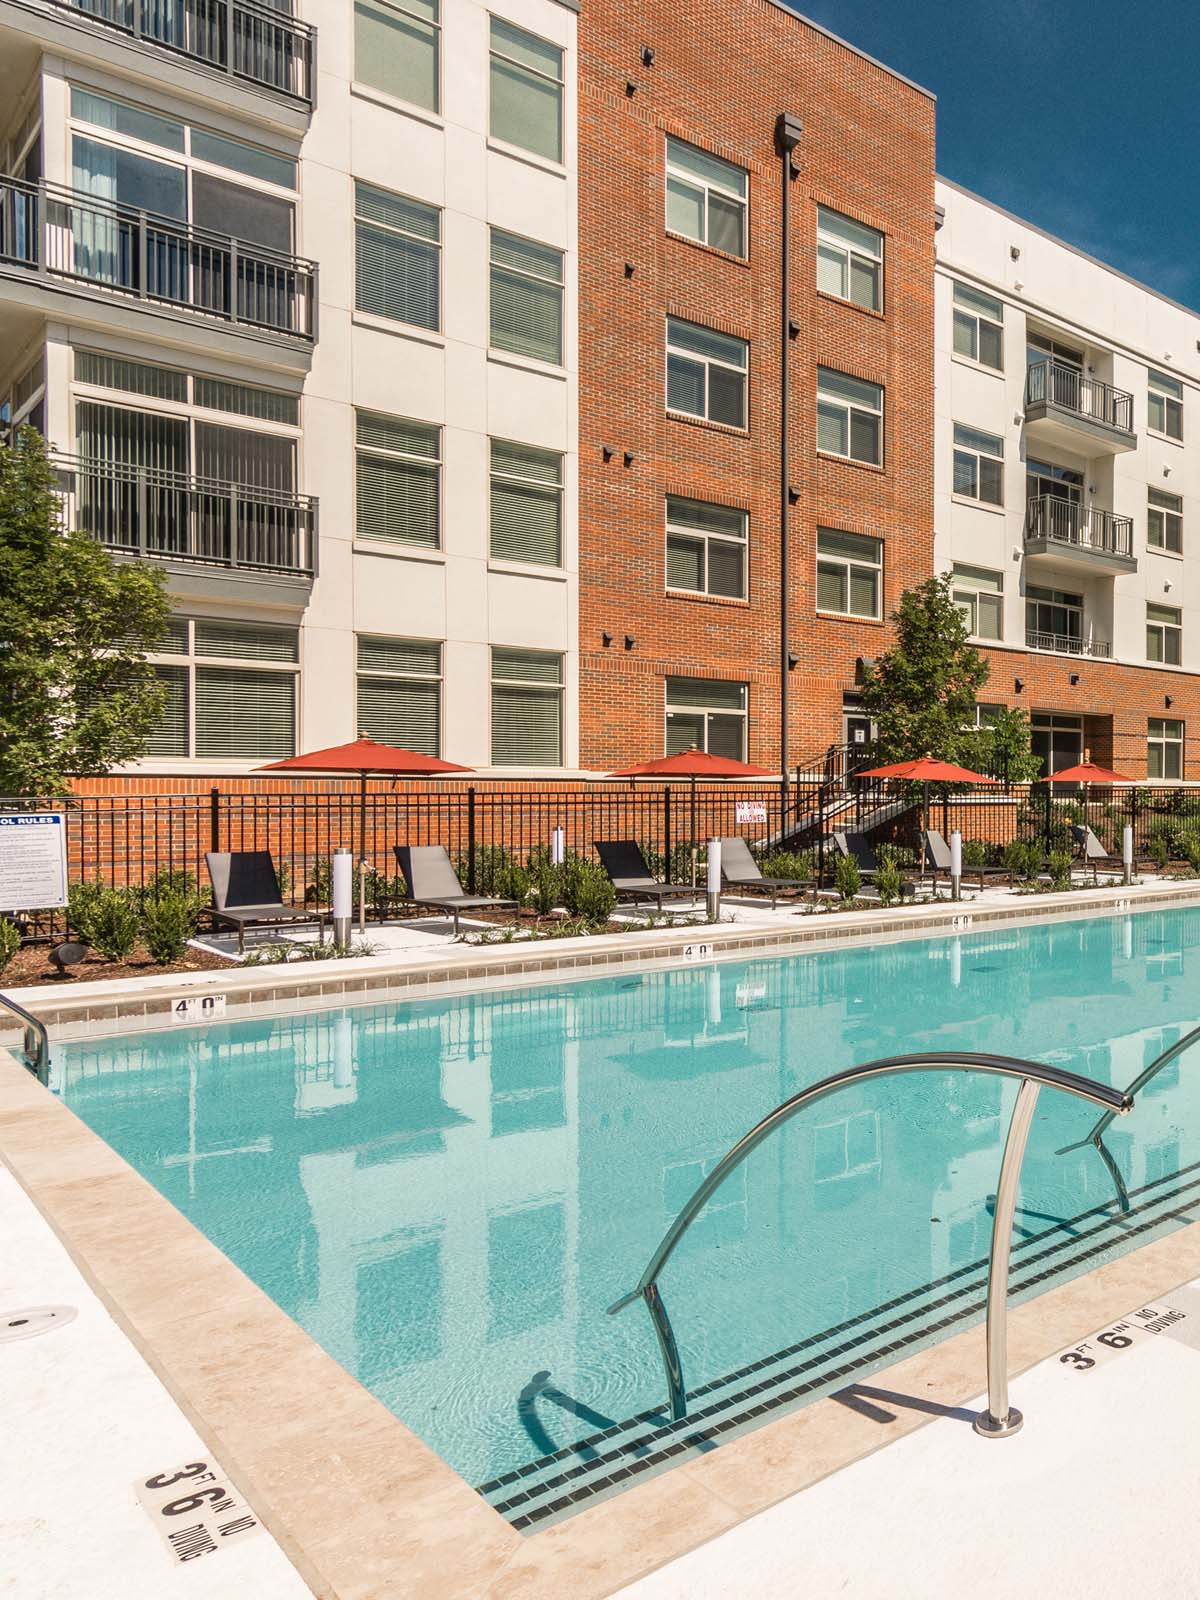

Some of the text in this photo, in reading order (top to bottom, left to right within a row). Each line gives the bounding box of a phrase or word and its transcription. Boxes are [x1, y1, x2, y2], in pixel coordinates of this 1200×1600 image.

[685, 946, 692, 955] 4
[175, 999, 188, 1011] 4
[1134, 1308, 1159, 1320] NO
[1143, 1310, 1187, 1333] DIVING
[1059, 1352, 1096, 1370] 3
[1096, 1332, 1133, 1349] 6
[145, 1462, 207, 1489] 3
[161, 1487, 226, 1517] 6
[217, 1515, 257, 1537] NO
[167, 1523, 219, 1562] DIVING
